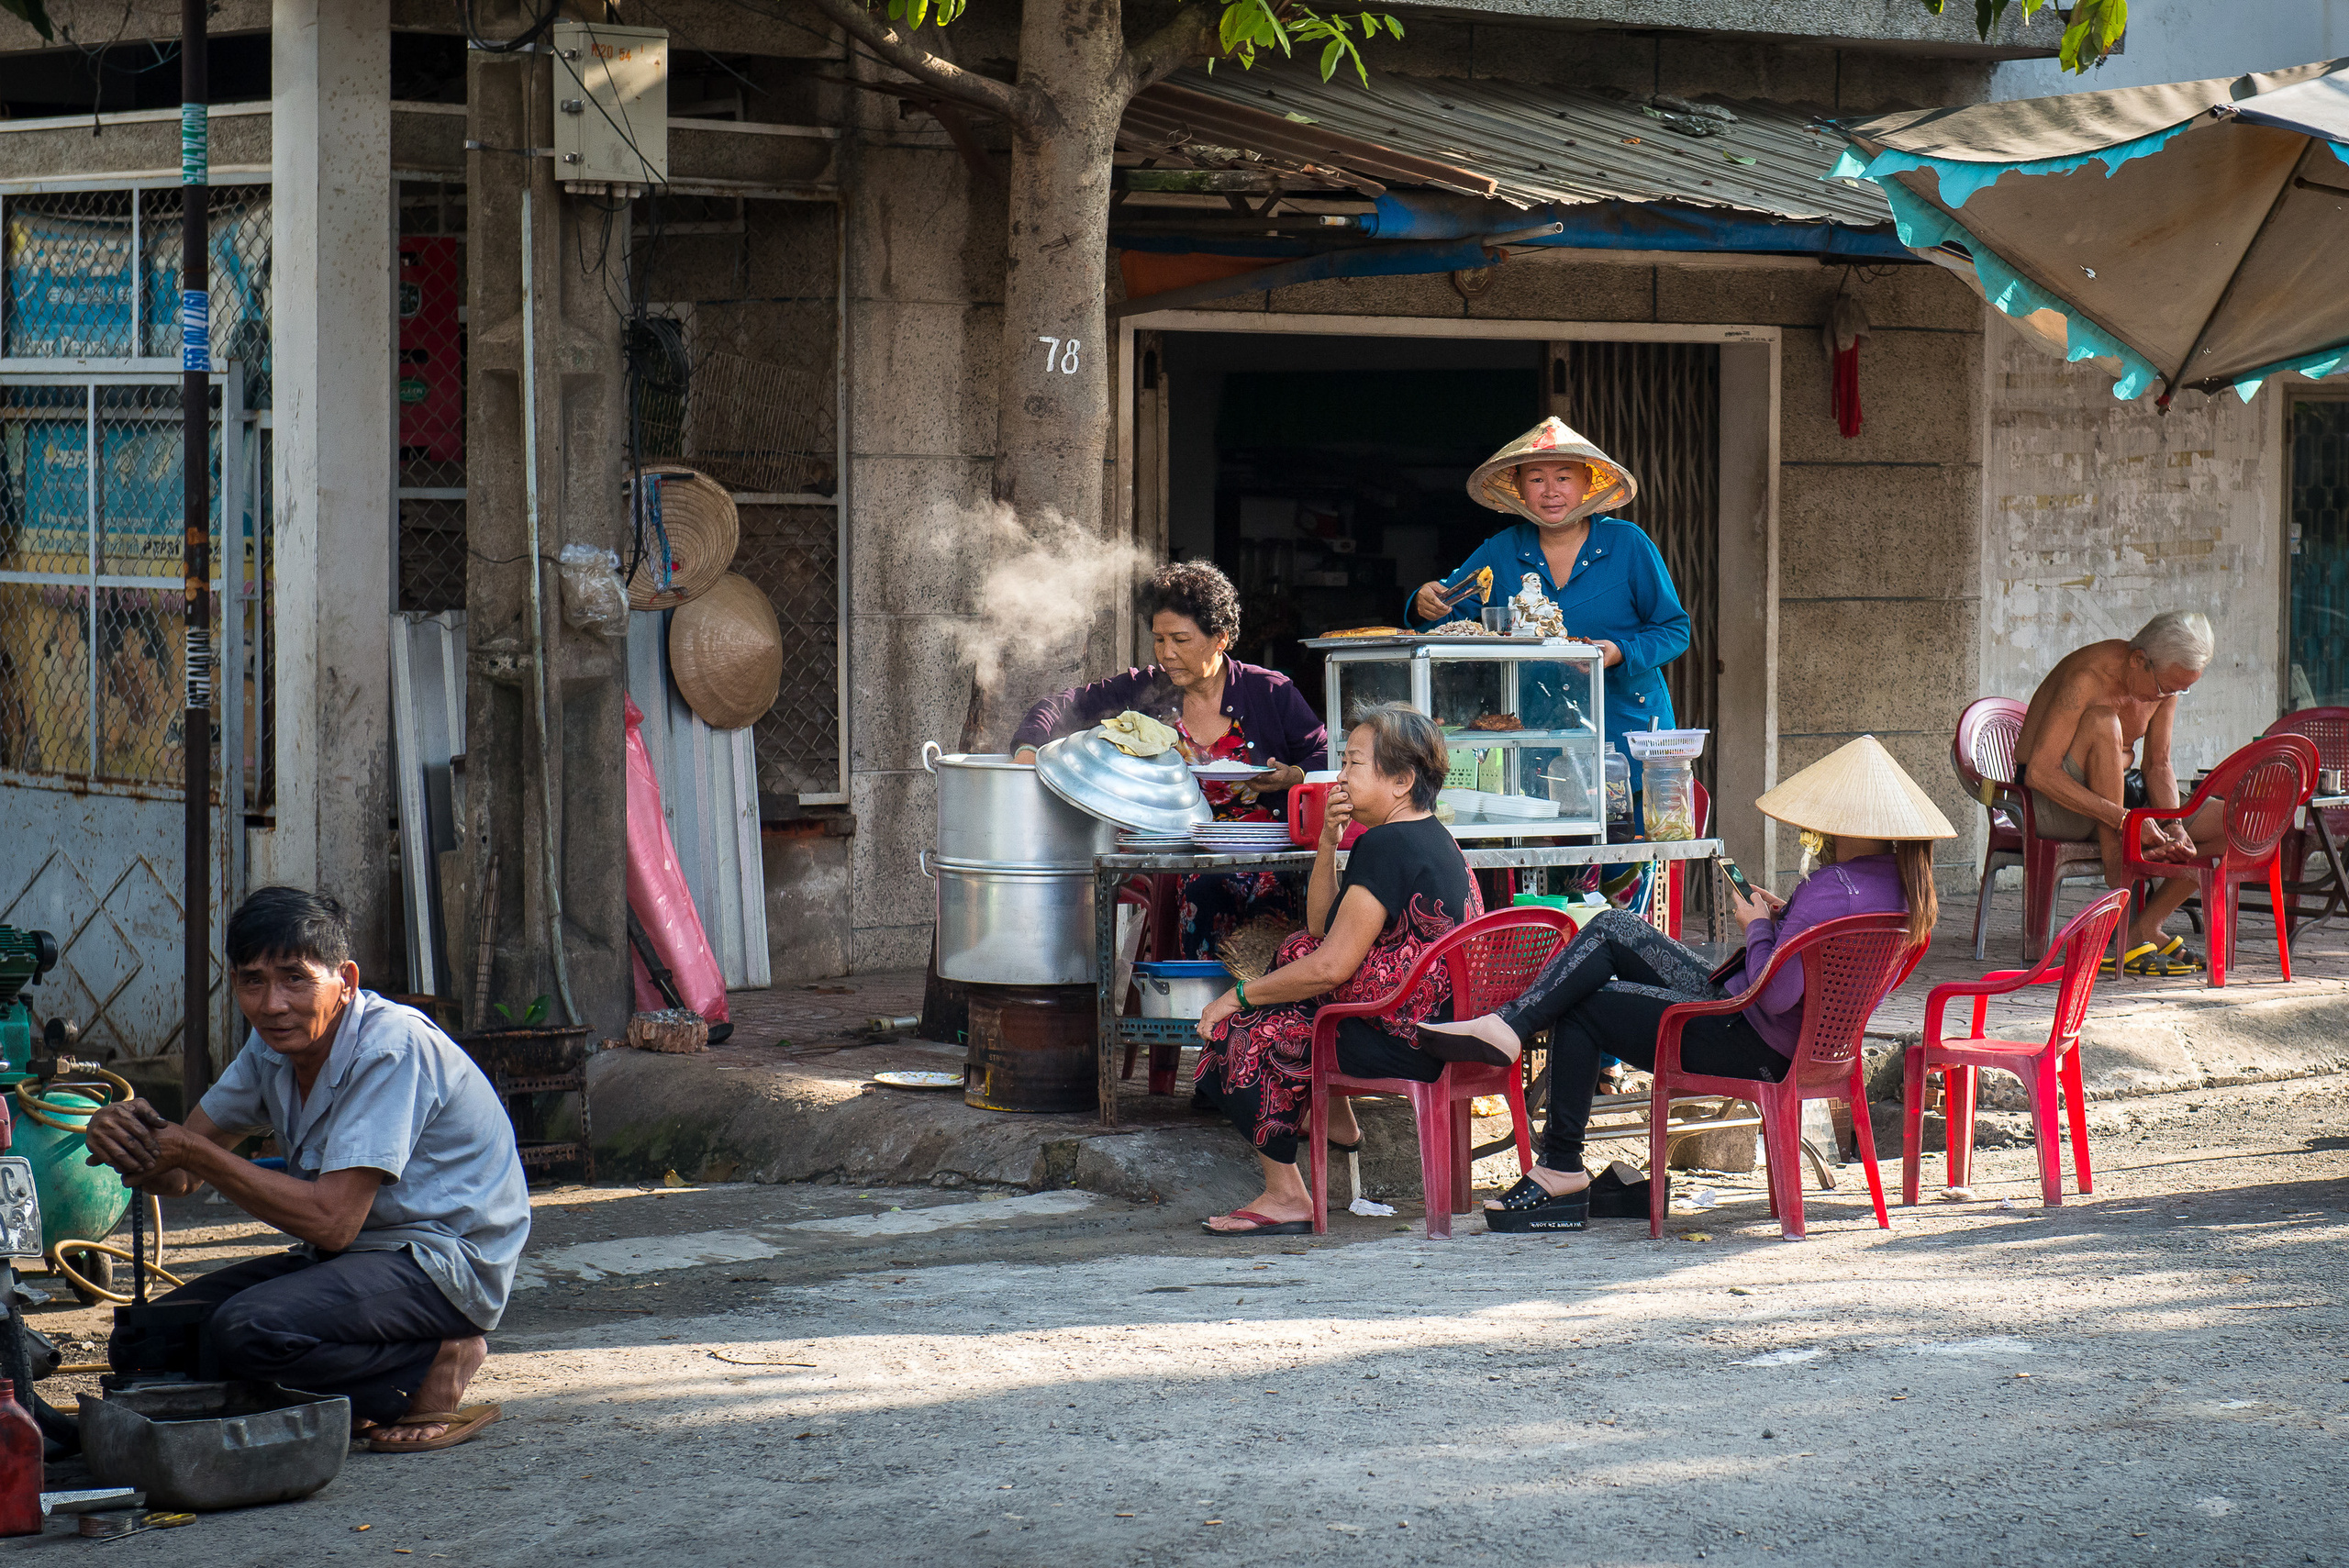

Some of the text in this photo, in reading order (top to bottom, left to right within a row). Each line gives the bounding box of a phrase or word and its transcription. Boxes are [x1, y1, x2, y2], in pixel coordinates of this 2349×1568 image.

[184, 292, 209, 322] 0977
[184, 324, 209, 346] 700
[1039, 336, 1081, 374] 78
